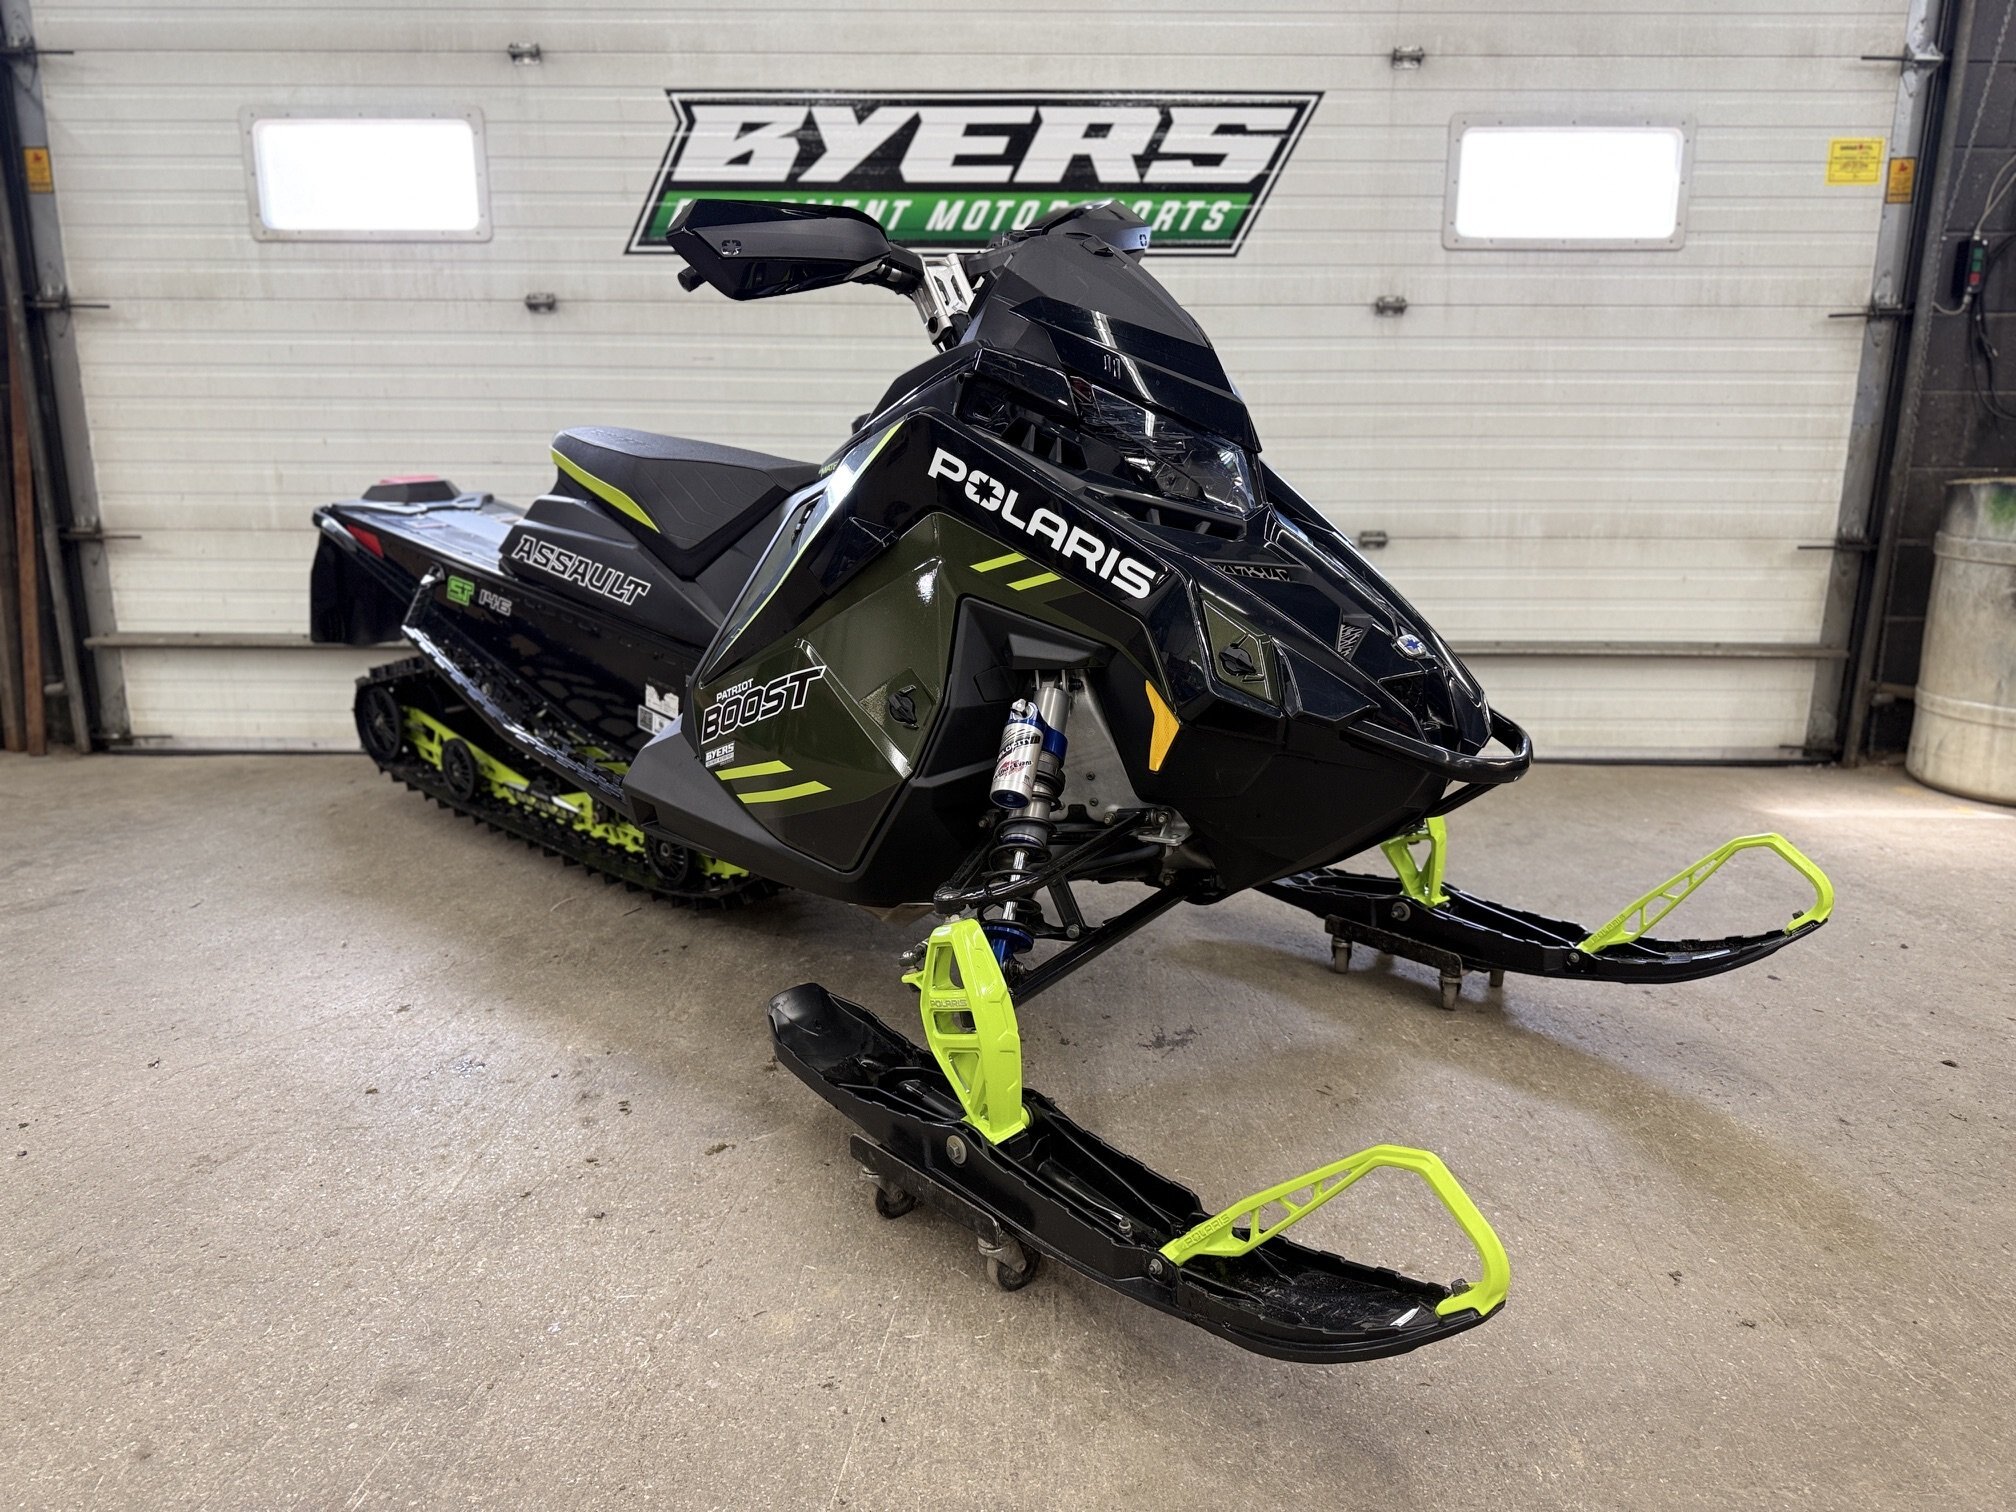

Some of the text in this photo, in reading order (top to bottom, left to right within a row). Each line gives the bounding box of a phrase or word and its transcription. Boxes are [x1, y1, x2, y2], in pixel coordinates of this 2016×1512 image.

[671, 105, 1298, 184] BYERS
[927, 447, 1156, 599] POLARIS
[512, 535, 651, 606] ASSAULT
[478, 589, 512, 616] 146
[701, 665, 827, 745] BOOST
[716, 678, 754, 702] PATRIOT
[705, 742, 735, 761] BYERS
[930, 999, 967, 1008] POLARIS
[1184, 1214, 1231, 1246] POLARIS
